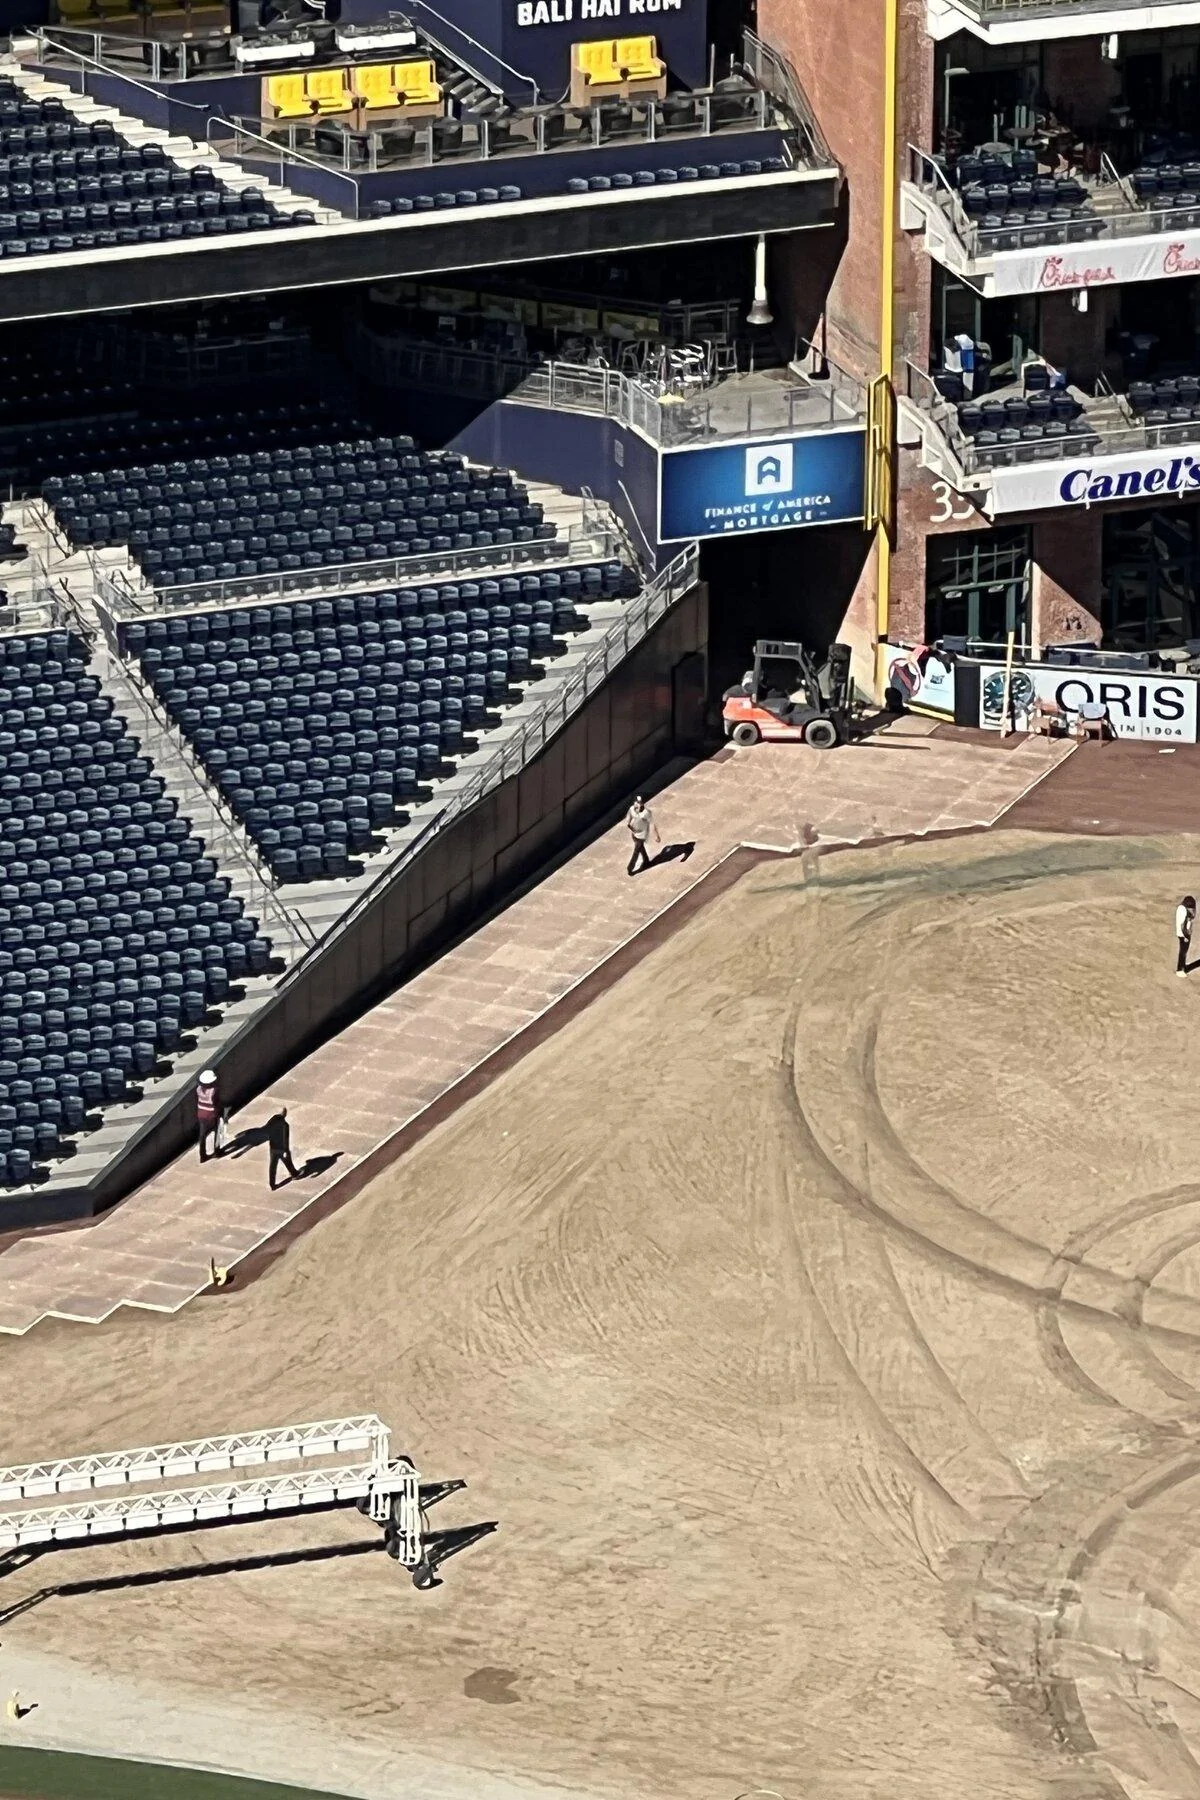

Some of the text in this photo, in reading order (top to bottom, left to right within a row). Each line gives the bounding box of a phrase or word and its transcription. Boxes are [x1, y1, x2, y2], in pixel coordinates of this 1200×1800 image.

[517, 0, 573, 26] BALI
[581, 0, 621, 19] HAI
[704, 502, 757, 519] FINANCE
[777, 495, 831, 509] AMERICA
[723, 510, 813, 530] MORTGAGE
[1054, 679, 1185, 721] ORIS
